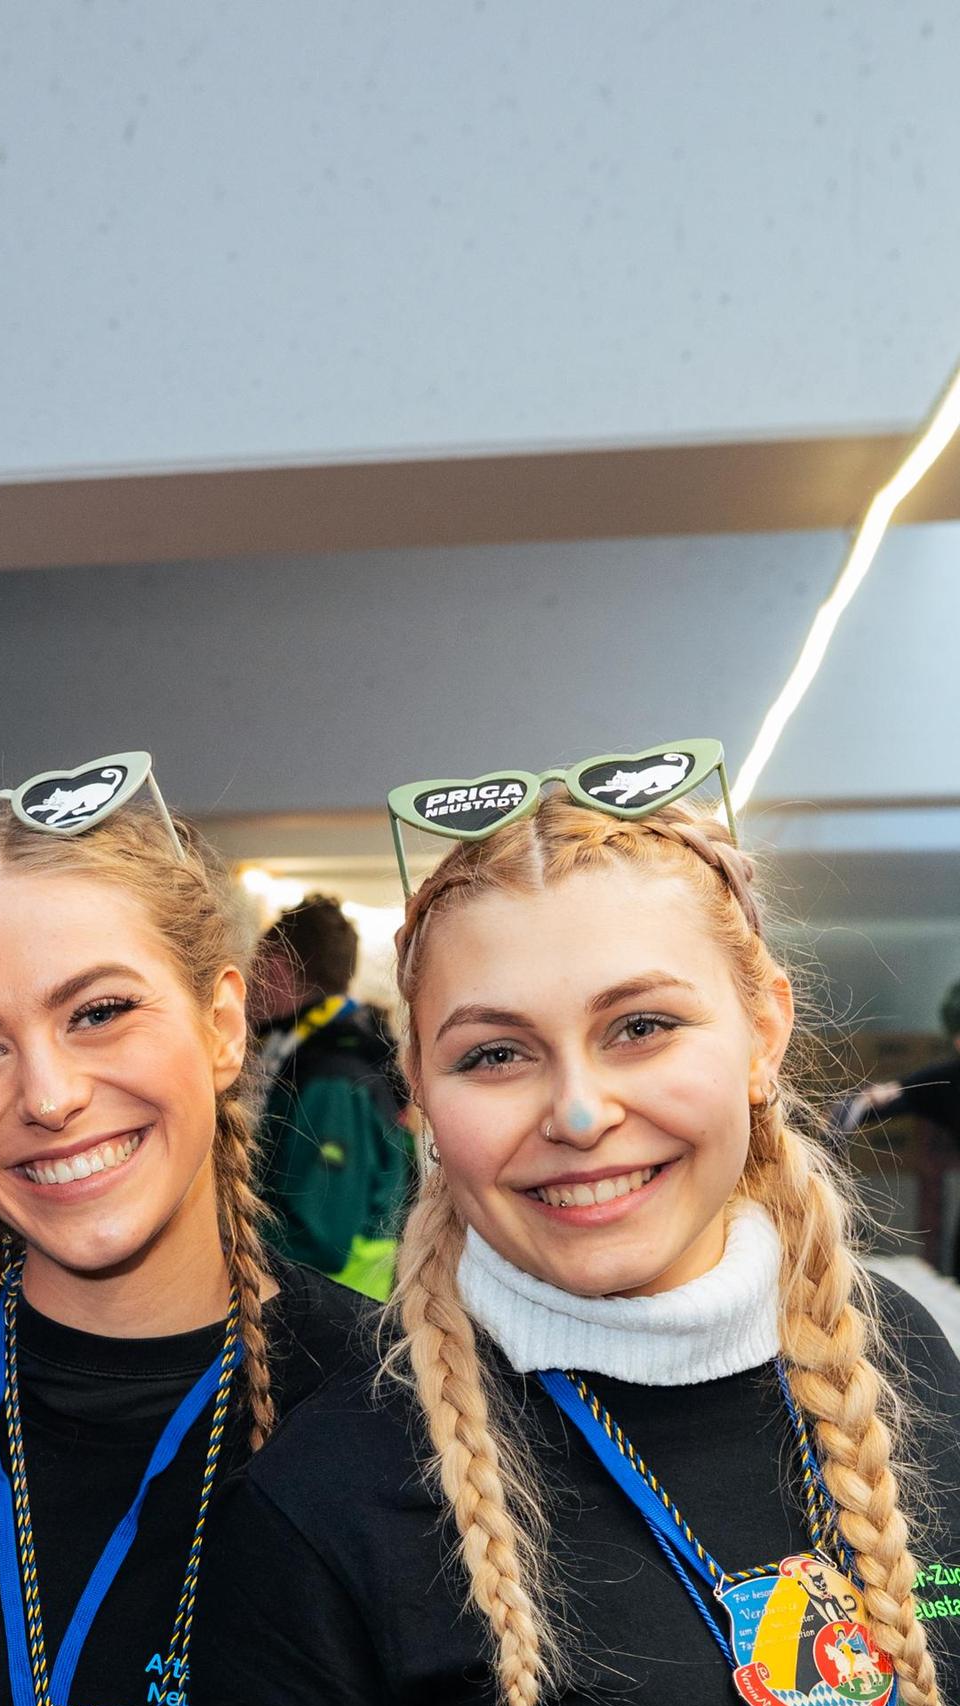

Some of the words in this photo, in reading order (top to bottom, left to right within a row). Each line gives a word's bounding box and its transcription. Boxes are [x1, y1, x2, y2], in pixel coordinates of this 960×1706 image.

[425, 797, 523, 818] NEUSTADT
[426, 783, 524, 808] PRIGA
[741, 1669, 759, 1700] Verein
